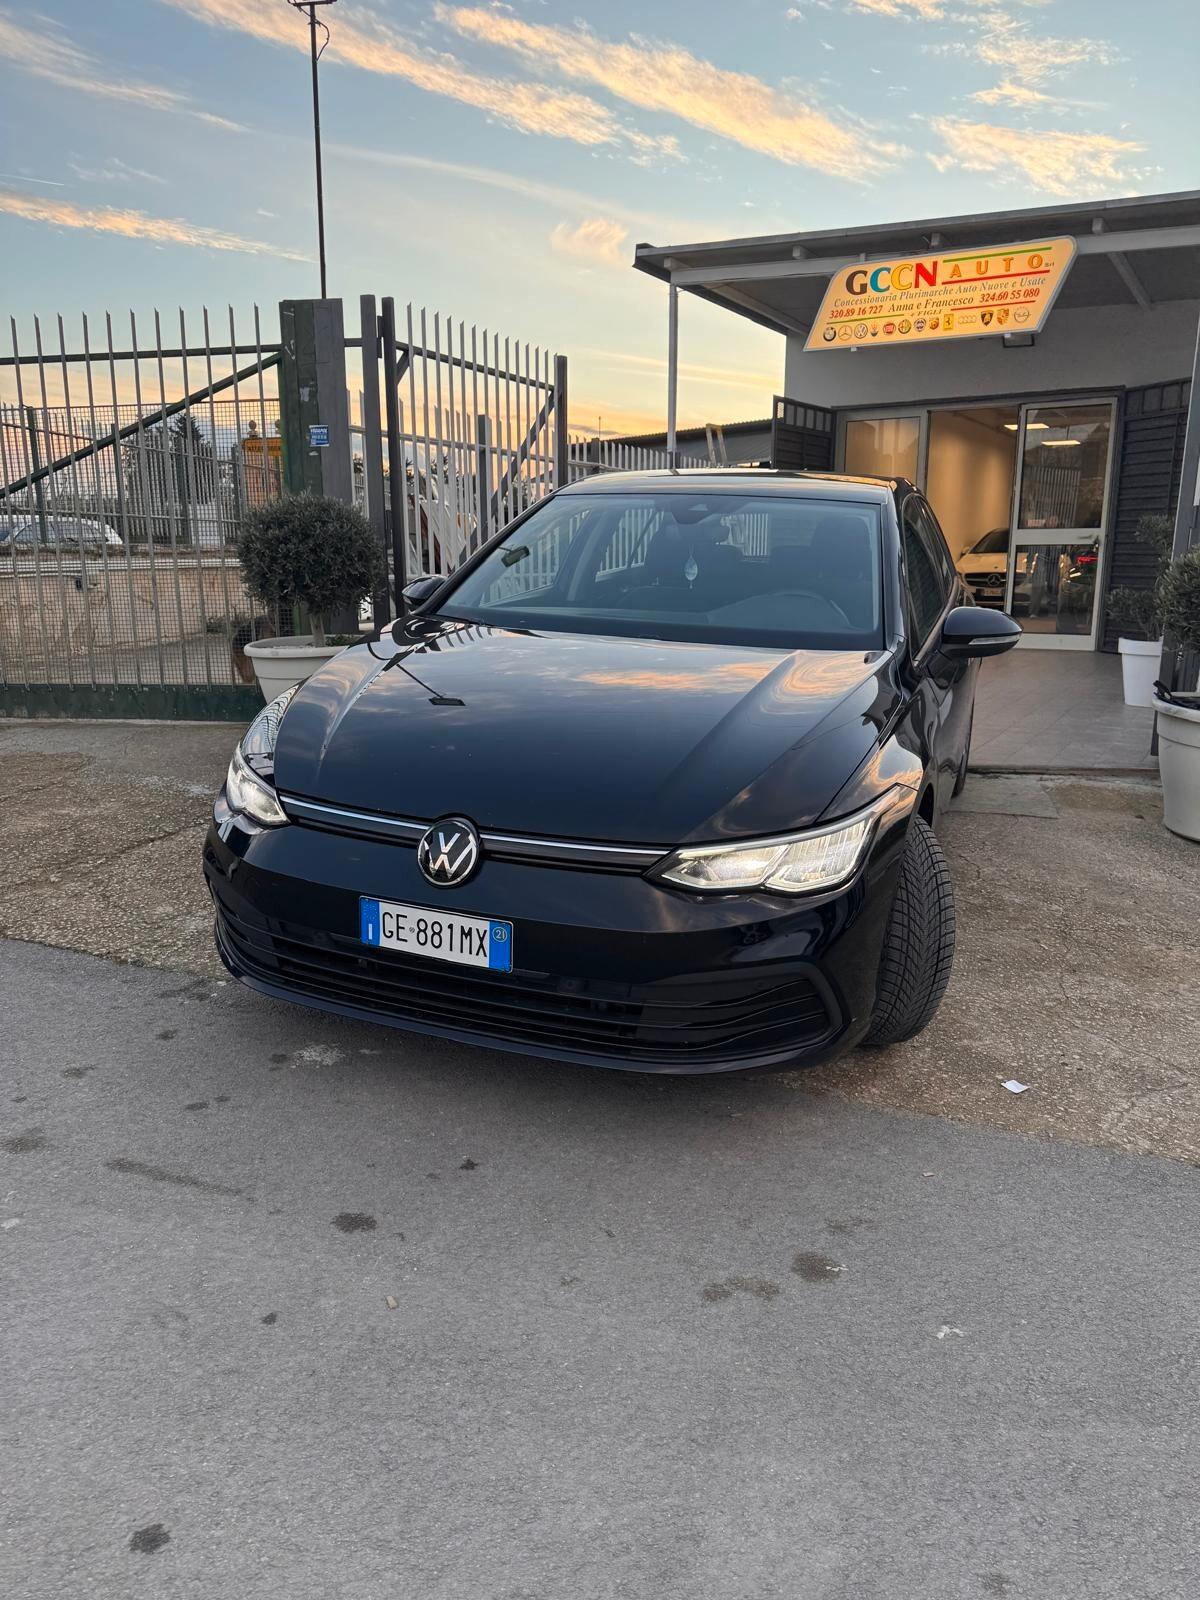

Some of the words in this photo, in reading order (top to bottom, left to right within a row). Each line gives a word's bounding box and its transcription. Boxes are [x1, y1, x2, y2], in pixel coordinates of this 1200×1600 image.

[845, 261, 938, 296] GCCN
[949, 254, 1043, 278] AUTO
[829, 308, 855, 319] 320.89
[856, 307, 867, 316] 16
[869, 305, 884, 314] 727
[888, 303, 914, 313] Anna
[924, 297, 974, 309] Francesco
[1010, 290, 1021, 300] 55
[1023, 288, 1040, 298] 080
[834, 293, 897, 308] Concessionaria
[899, 286, 954, 300] Plurimarche
[955, 284, 977, 294] Auto
[979, 281, 1008, 292] Nuove
[1011, 280, 1017, 288] e
[1020, 277, 1046, 287] Usate
